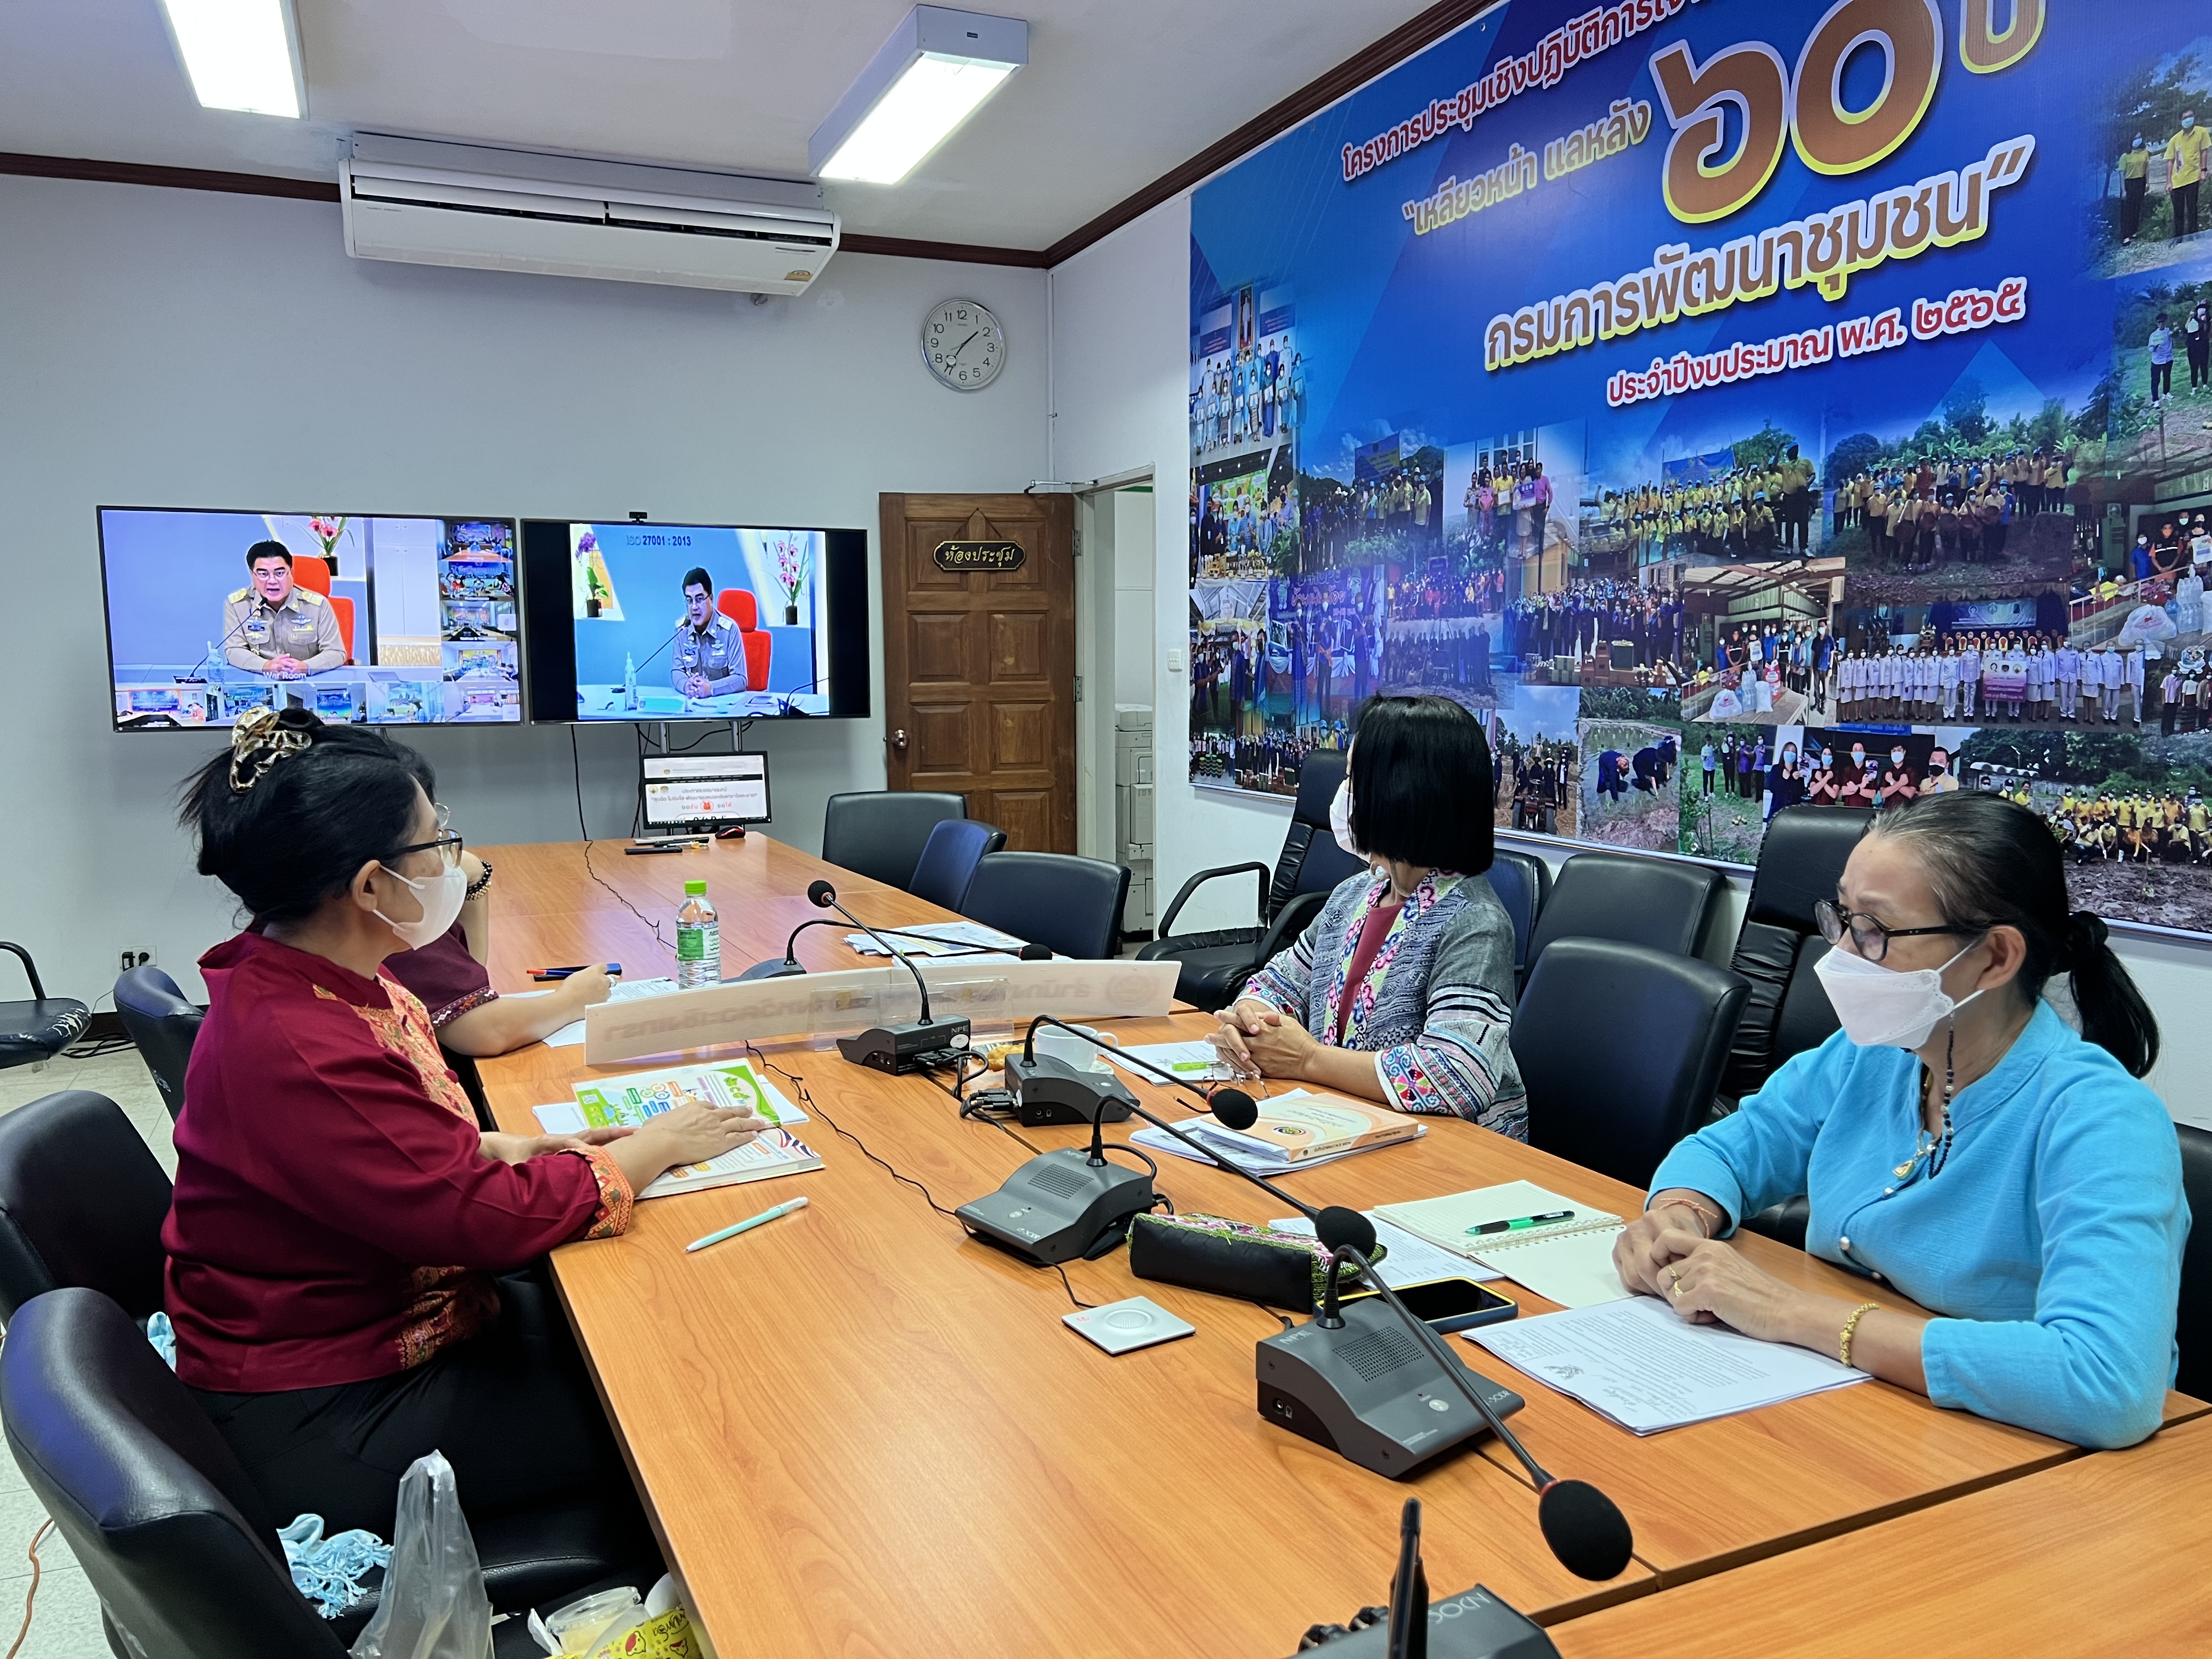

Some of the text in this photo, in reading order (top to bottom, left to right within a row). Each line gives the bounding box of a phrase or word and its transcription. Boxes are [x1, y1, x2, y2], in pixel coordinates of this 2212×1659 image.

[1545, 101, 1650, 178] แลหลัง
[945, 312, 952, 321] 11
[957, 310, 967, 320] 12
[934, 324, 944, 333] 10
[983, 327, 990, 337] 2
[930, 338, 939, 348] 9
[1610, 281, 2024, 403] ประจำปีงบประมาณ พ.ศ. ๒๕๖๕
[987, 343, 995, 352] 3
[935, 353, 943, 363] 8
[983, 357, 990, 367] 4
[959, 371, 967, 380] 6
[973, 368, 980, 377] 5
[627, 535, 641, 545] ISO
[642, 535, 665, 546] 27001
[672, 535, 691, 546] 2013
[945, 545, 1015, 567] ห้องประชุม
[282, 671, 307, 680] Room
[951, 1025, 969, 1034] NPE
[1279, 1330, 1311, 1345] NPE
